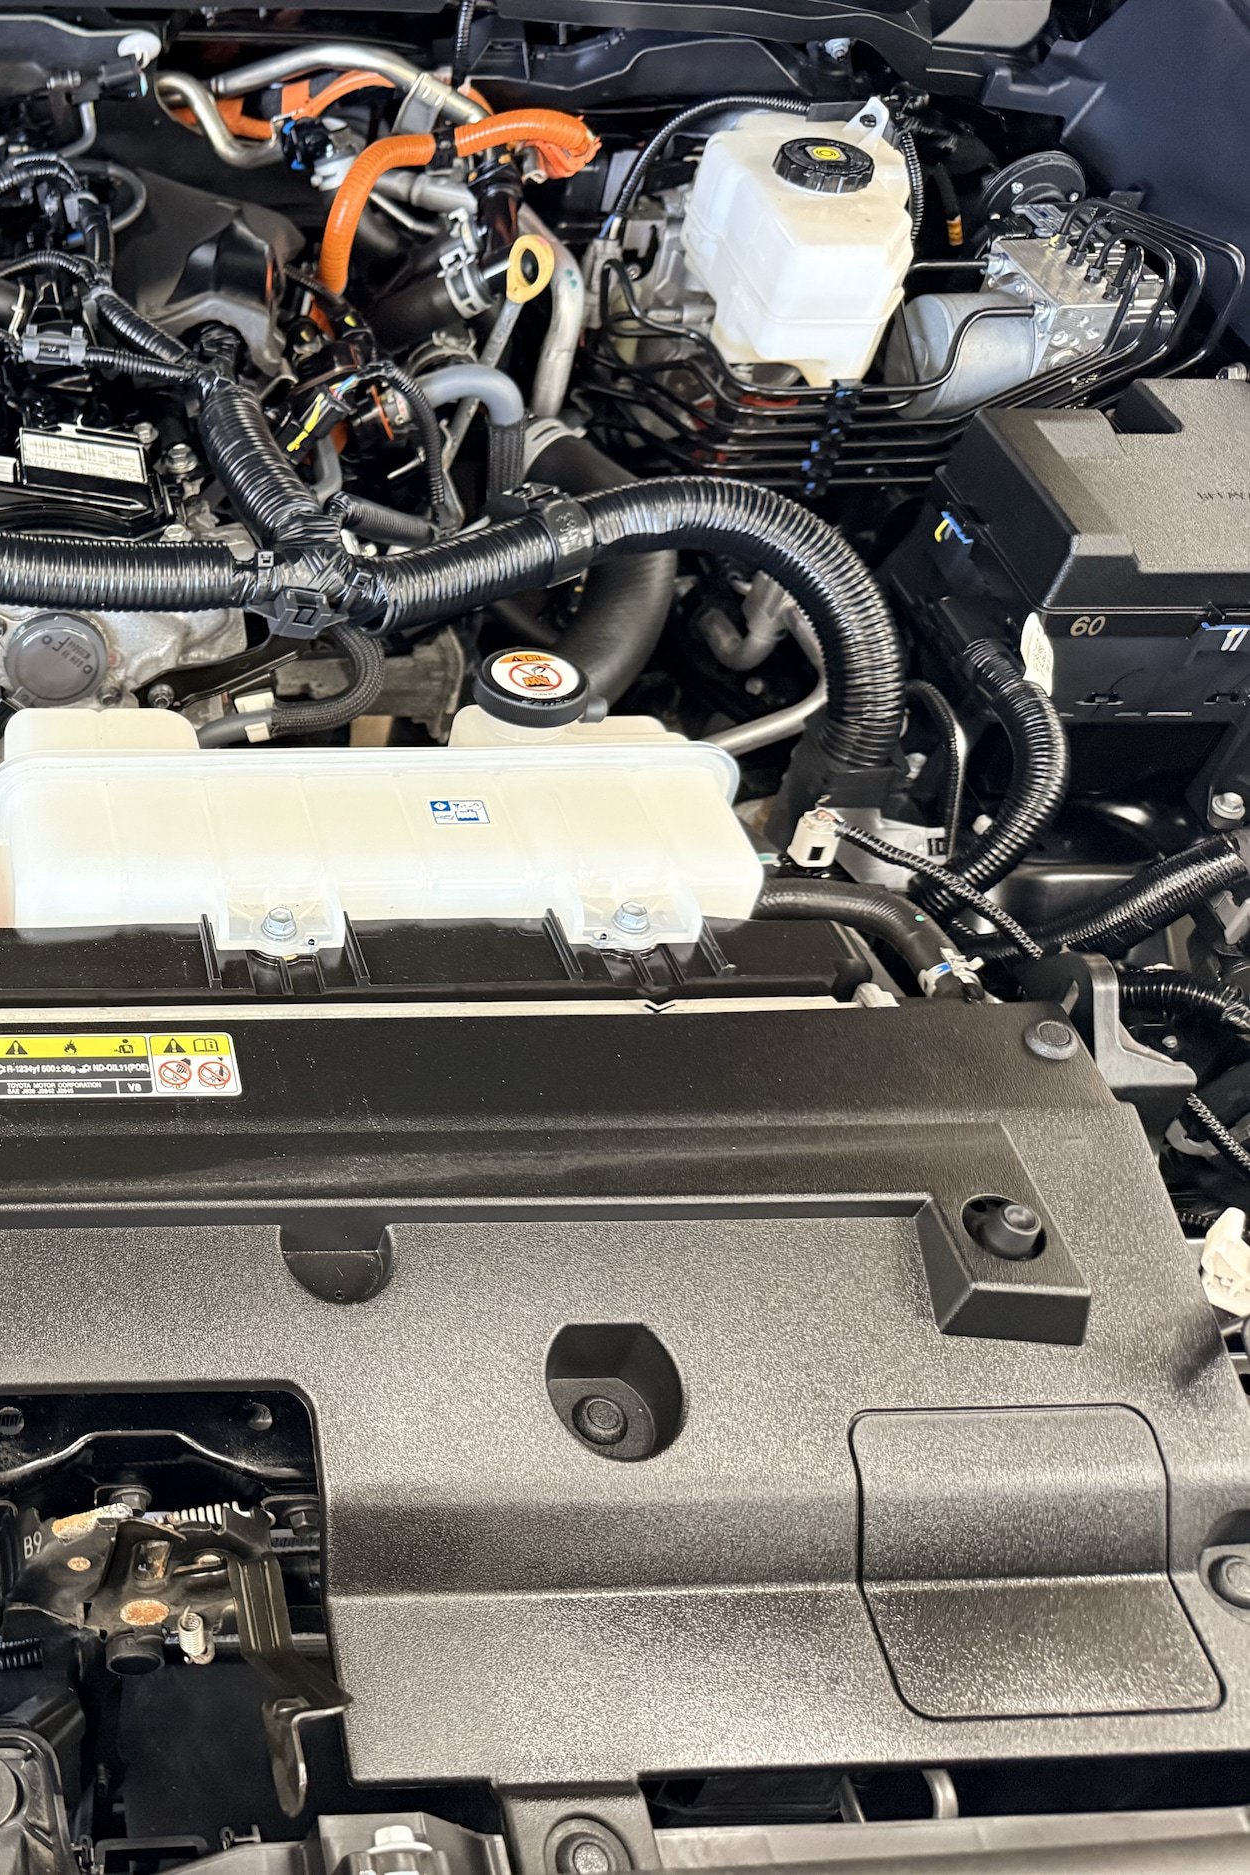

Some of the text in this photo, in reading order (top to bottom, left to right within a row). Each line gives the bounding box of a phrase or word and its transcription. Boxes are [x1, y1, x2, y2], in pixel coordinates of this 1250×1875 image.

[1069, 615, 1106, 637] 60
[6, 1064, 40, 1074] R-1234yf
[23, 1530, 43, 1560] B9
